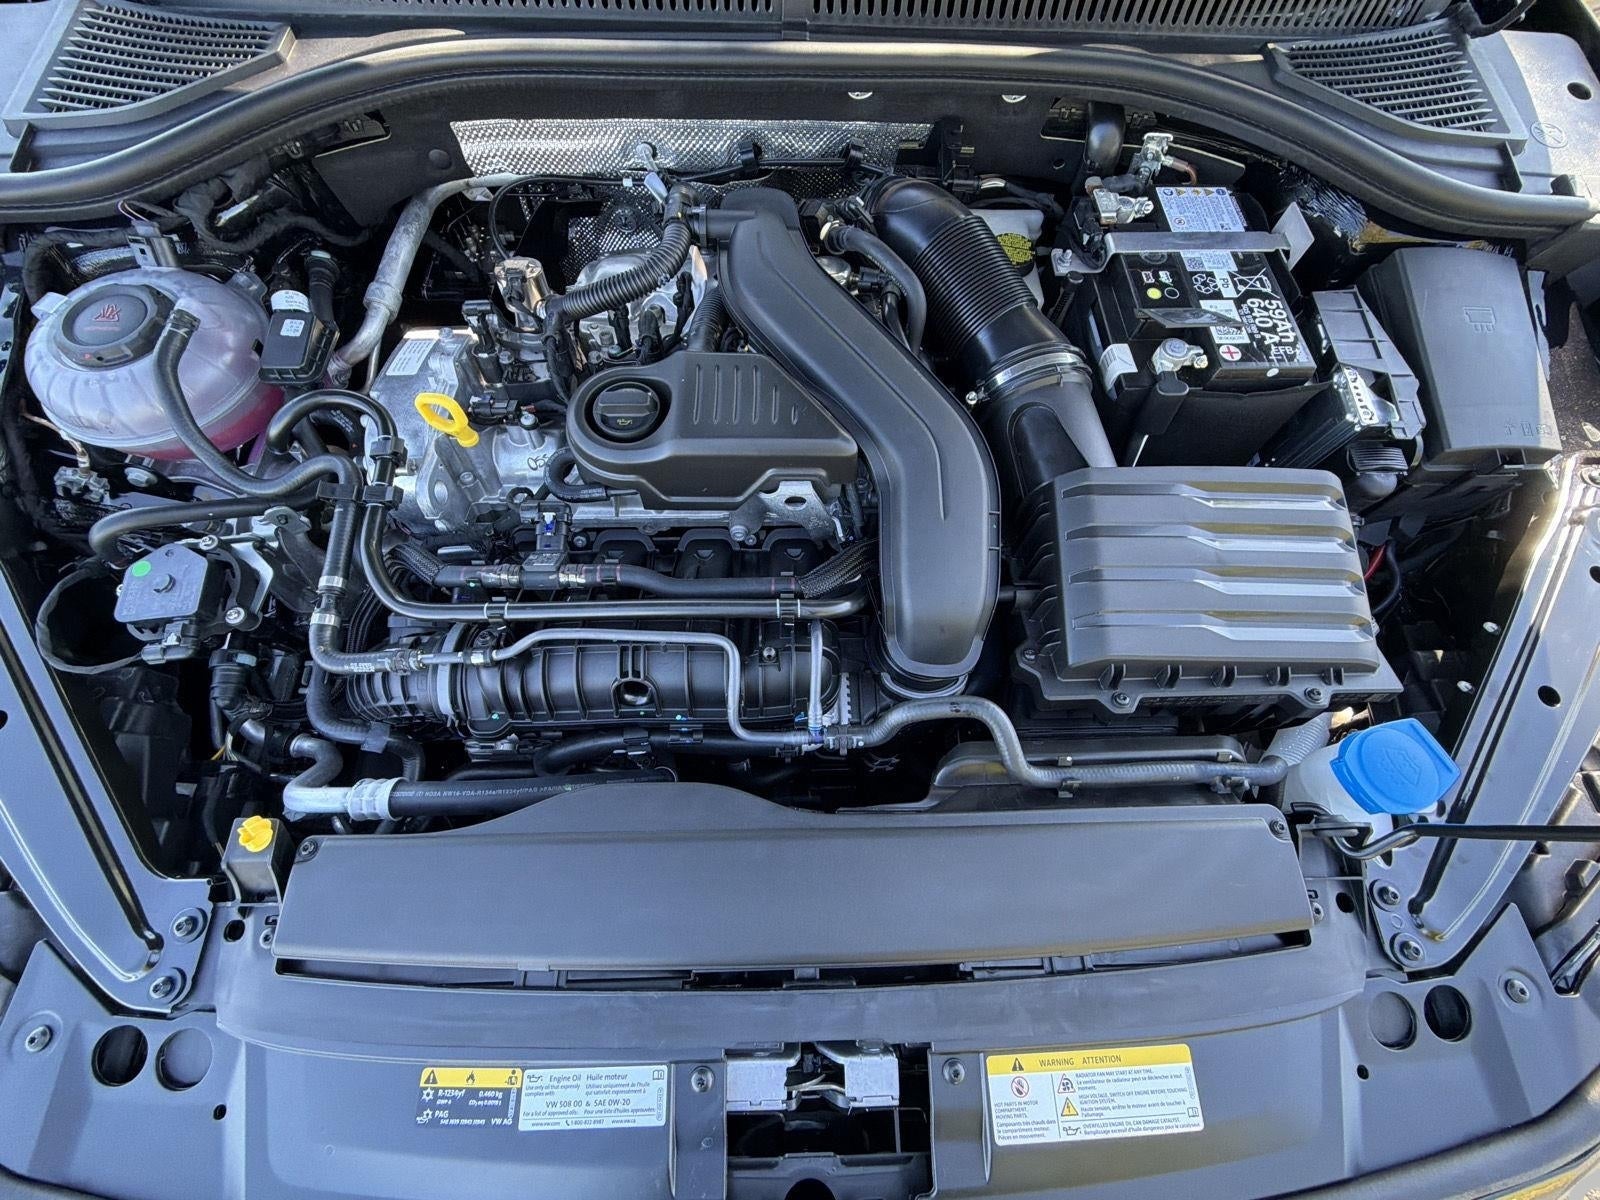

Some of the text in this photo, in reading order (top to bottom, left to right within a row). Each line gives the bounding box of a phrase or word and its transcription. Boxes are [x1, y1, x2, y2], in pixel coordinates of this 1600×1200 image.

[1218, 278, 1230, 289] Pb
[1246, 298, 1281, 345] 640 A
[1264, 299, 1296, 342] 59Ah
[1039, 1055, 1122, 1068] WARNING ATTENTION
[550, 1075, 570, 1083] Engine
[438, 1089, 465, 1099] R-1234yf
[496, 1091, 503, 1099] kg
